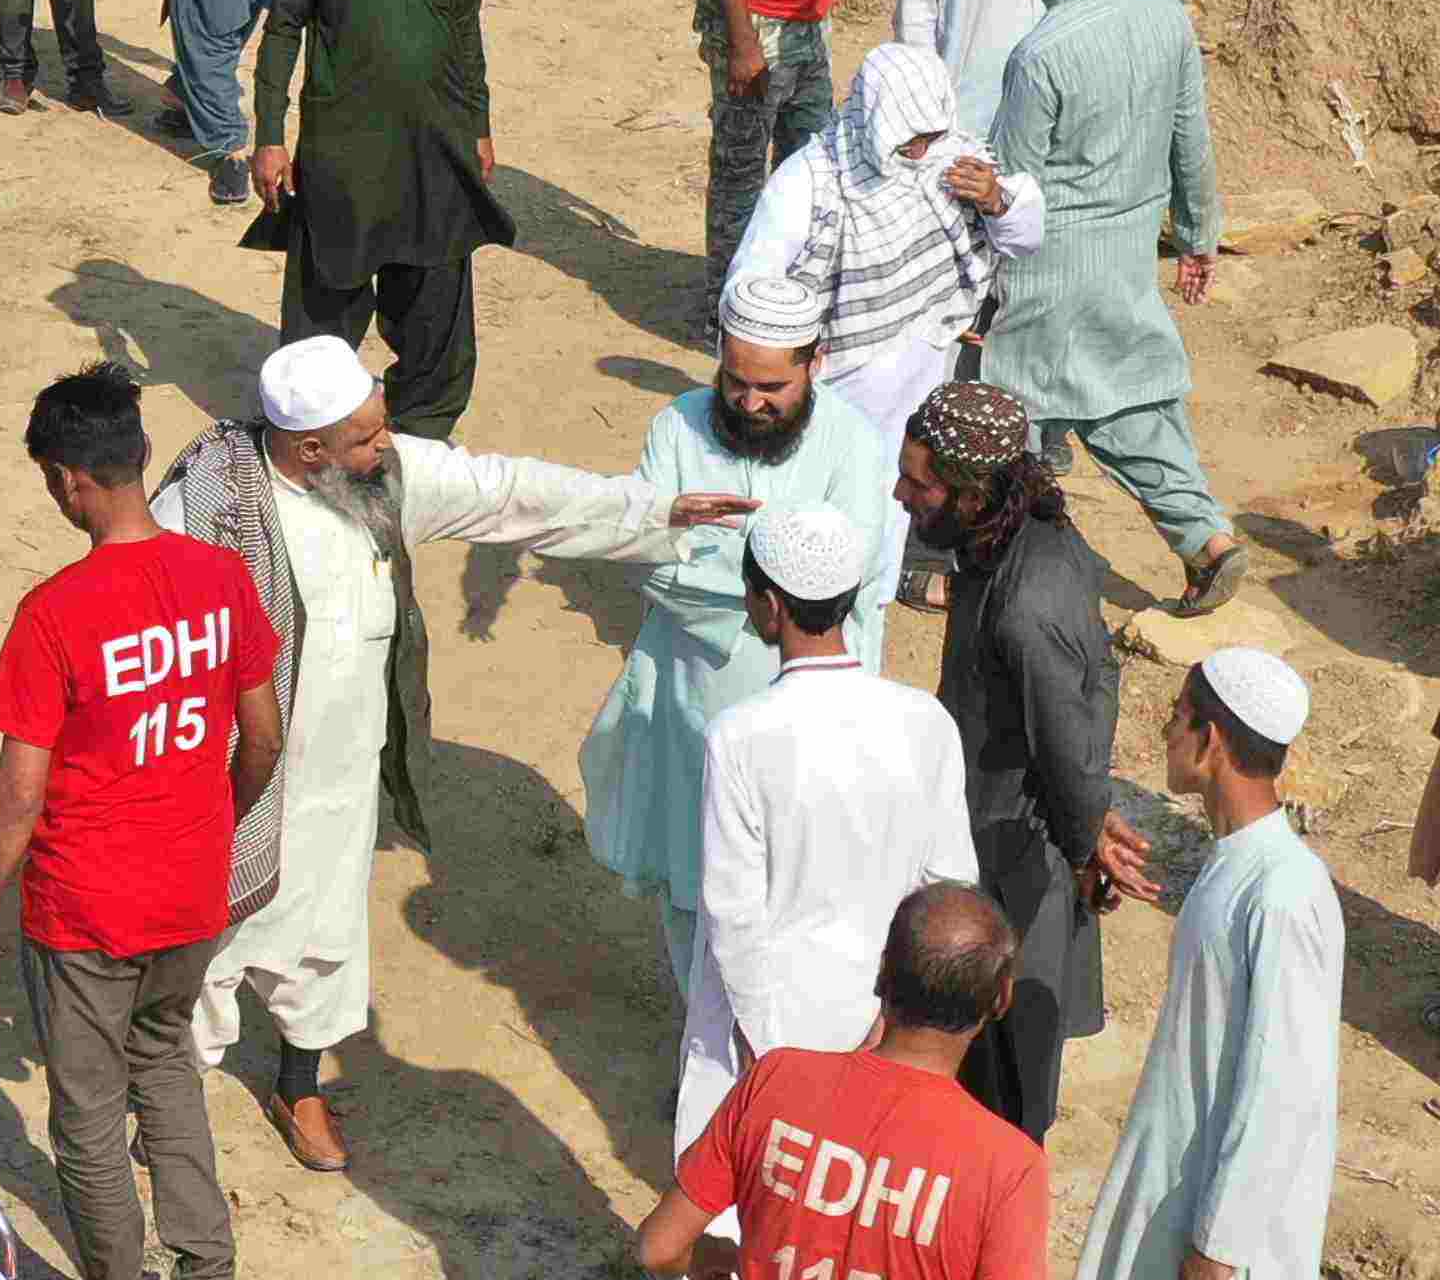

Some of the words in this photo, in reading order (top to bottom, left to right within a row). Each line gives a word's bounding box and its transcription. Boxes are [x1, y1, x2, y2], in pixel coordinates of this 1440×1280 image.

[101, 607, 231, 697] EDHI
[128, 696, 207, 766] 115
[760, 1118, 952, 1248] EDHI
